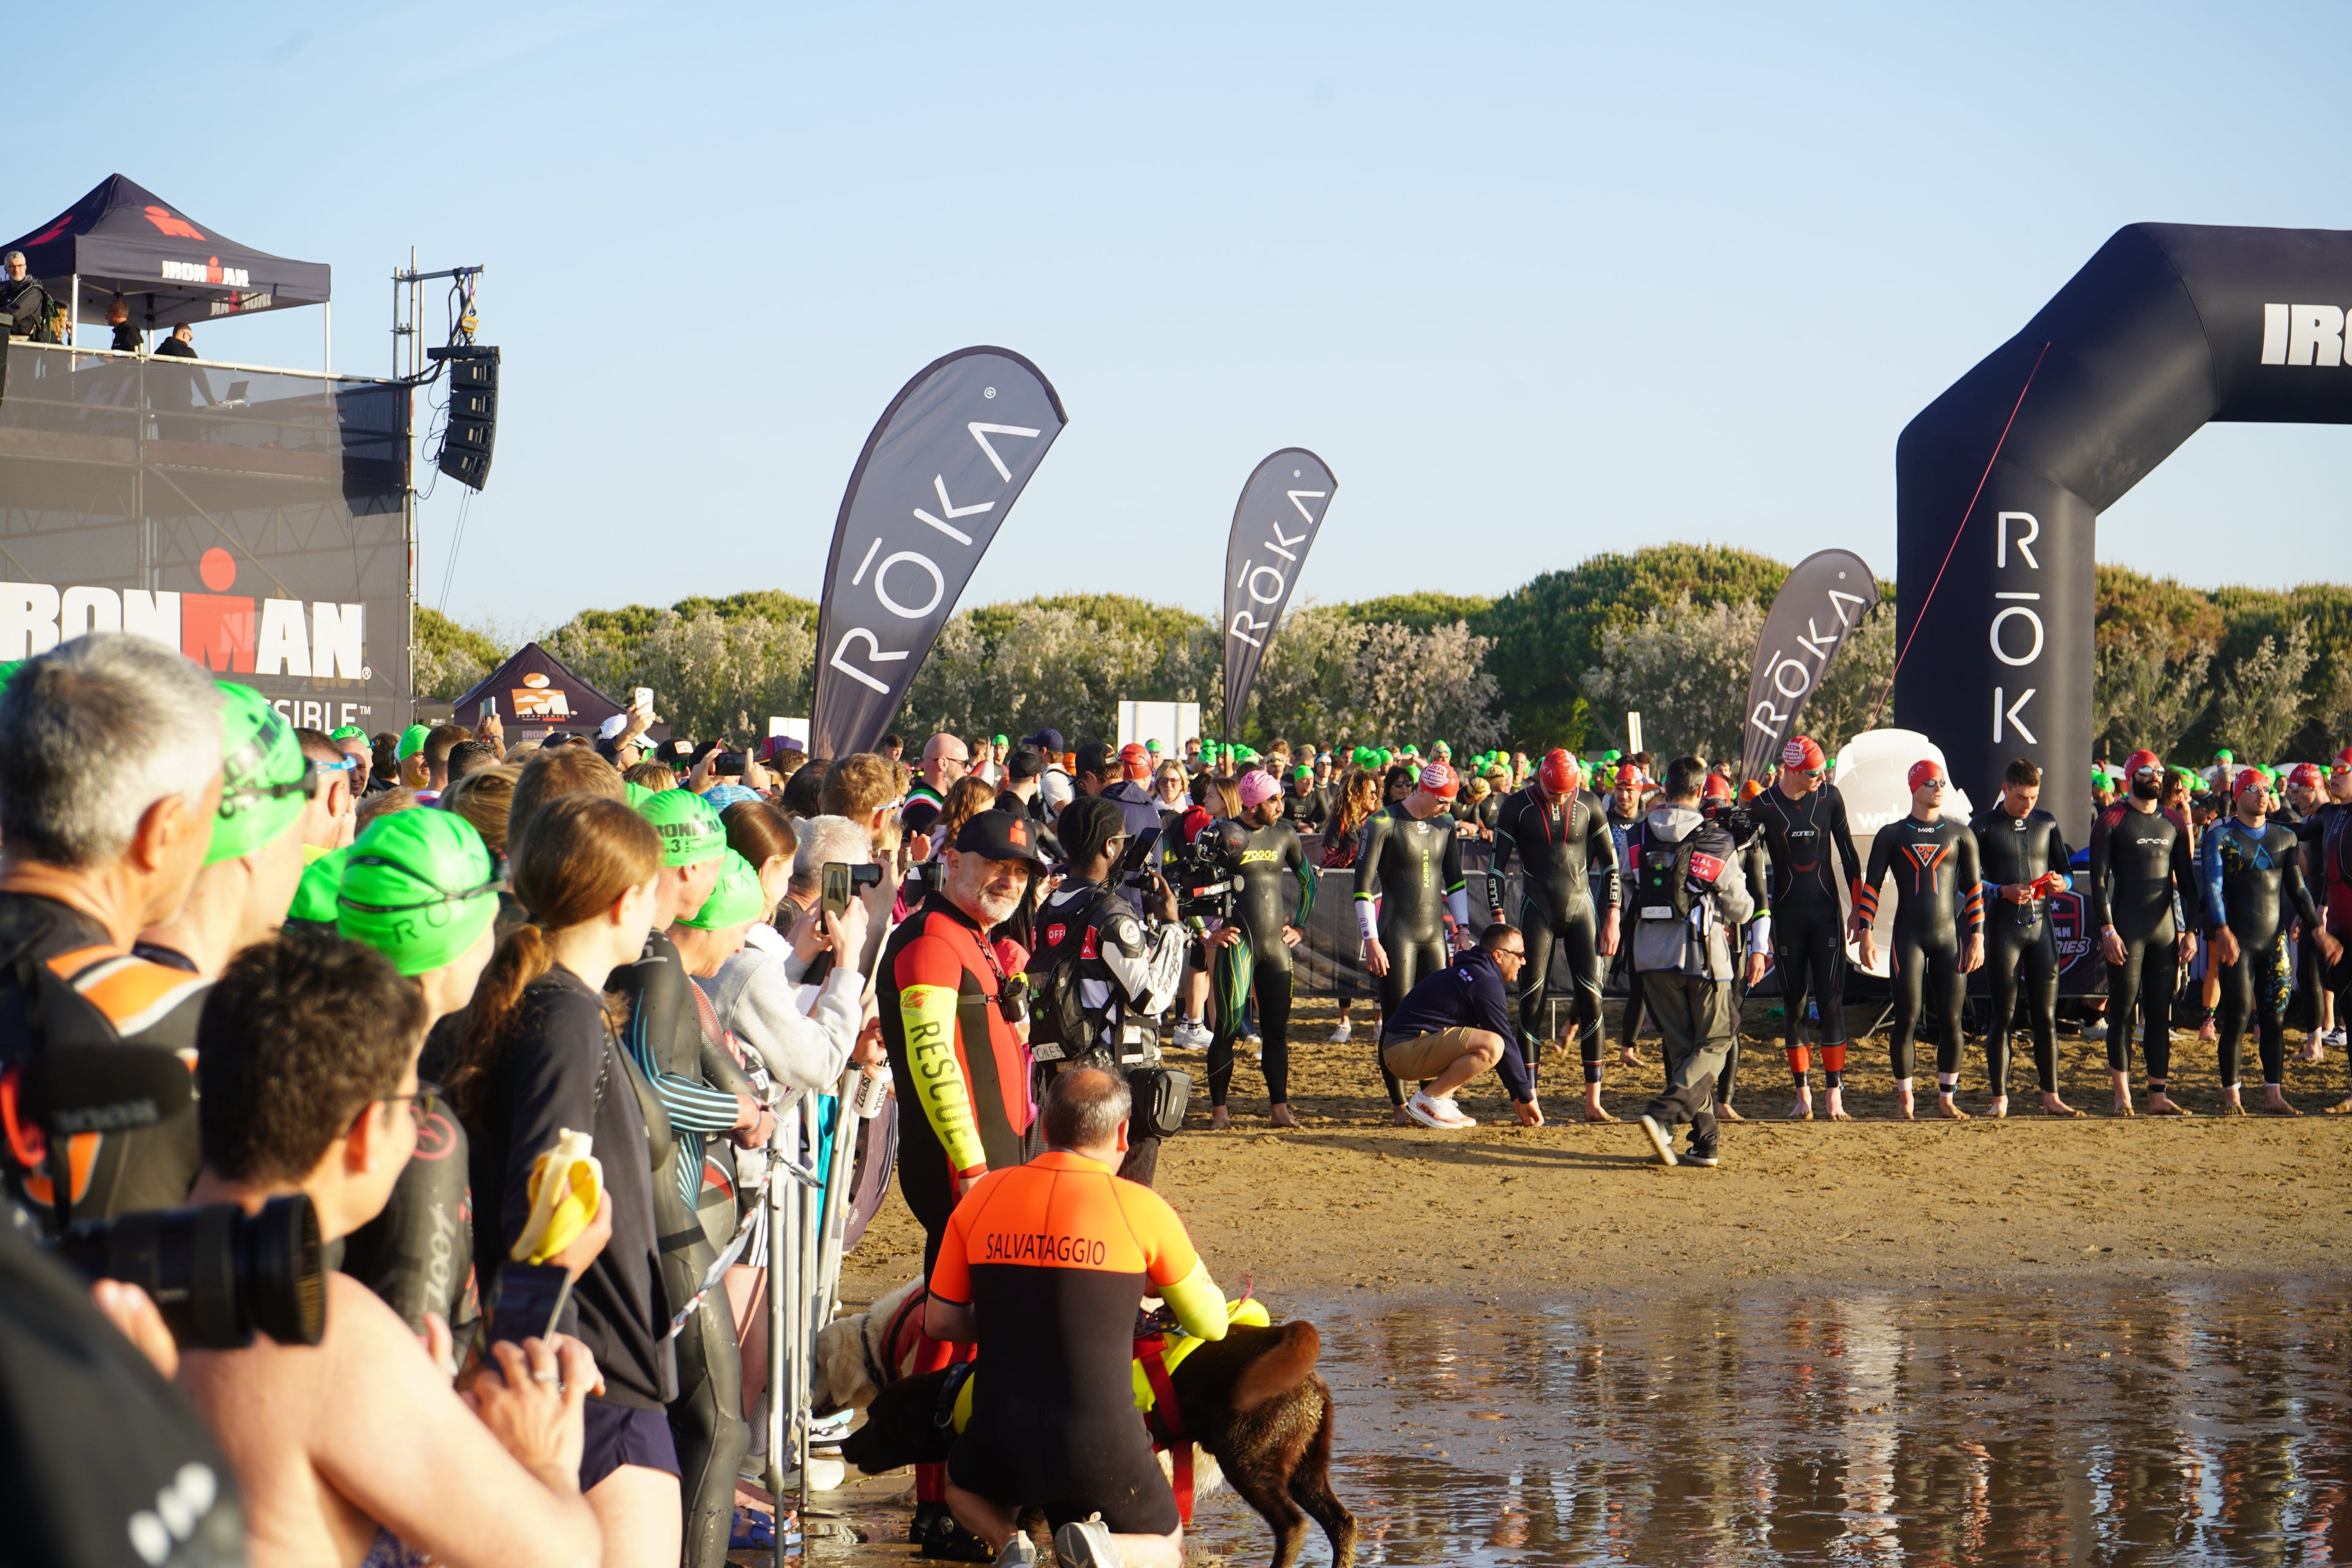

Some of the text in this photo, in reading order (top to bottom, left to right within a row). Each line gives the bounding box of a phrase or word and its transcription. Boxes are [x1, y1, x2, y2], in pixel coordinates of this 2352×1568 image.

[162, 256, 249, 287] IRONMAN
[1240, 850, 1278, 865] ZOGGS
[1488, 878, 1499, 907] HUUB
[1610, 873, 1619, 900] HUUB
[910, 1021, 977, 1145] RESCUE
[986, 1233, 1106, 1266] SALVATAGGIO
